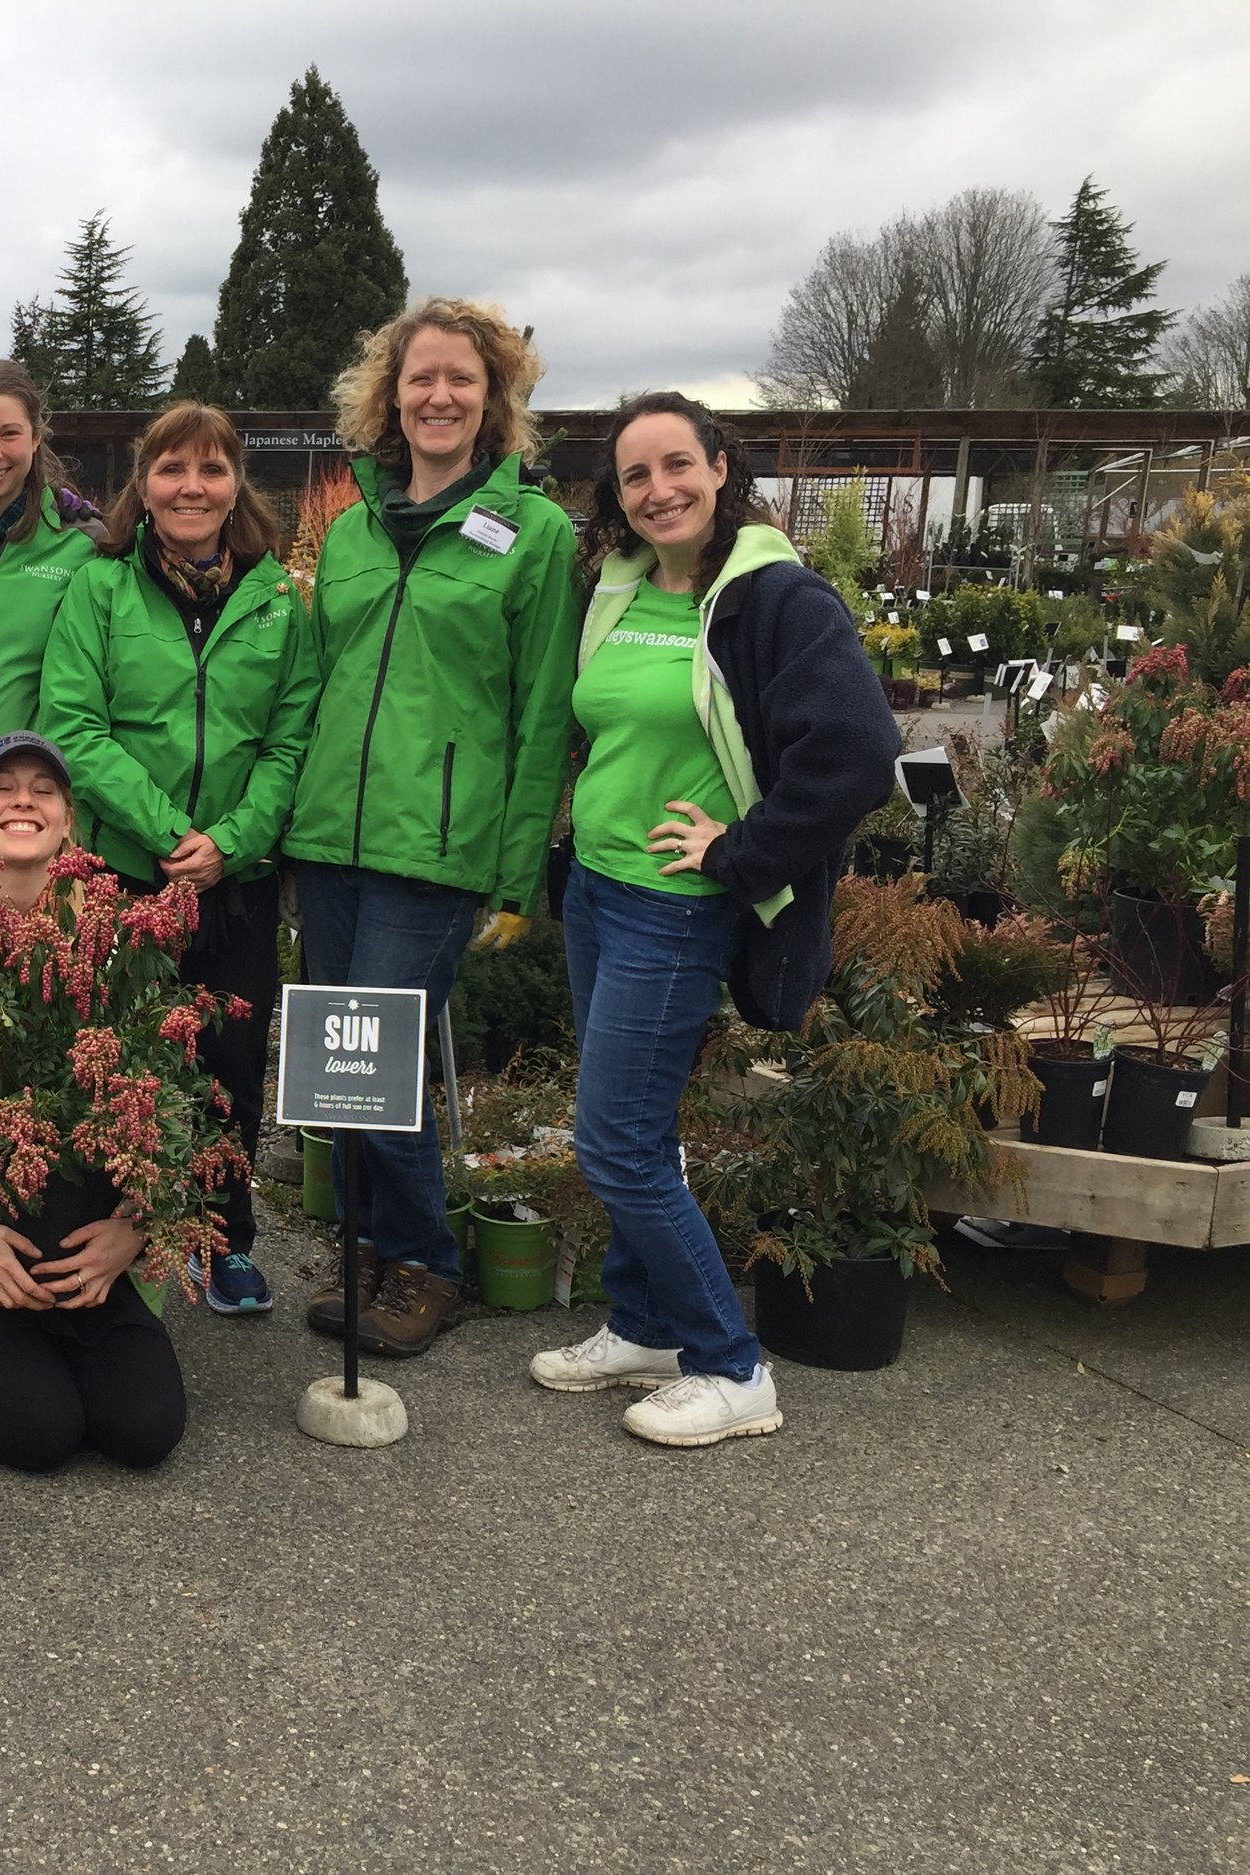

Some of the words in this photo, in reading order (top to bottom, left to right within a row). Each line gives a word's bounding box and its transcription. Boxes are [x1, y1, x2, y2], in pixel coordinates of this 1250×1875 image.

[244, 432, 299, 448] Japanese
[324, 1014, 380, 1053] SUN
[325, 1056, 377, 1075] lovers
[314, 1092, 330, 1101] These
[330, 1094, 347, 1102] plants
[347, 1095, 364, 1103] prefer
[371, 1096, 386, 1104] least
[319, 1101, 334, 1109] hours
[334, 1102, 341, 1110] of
